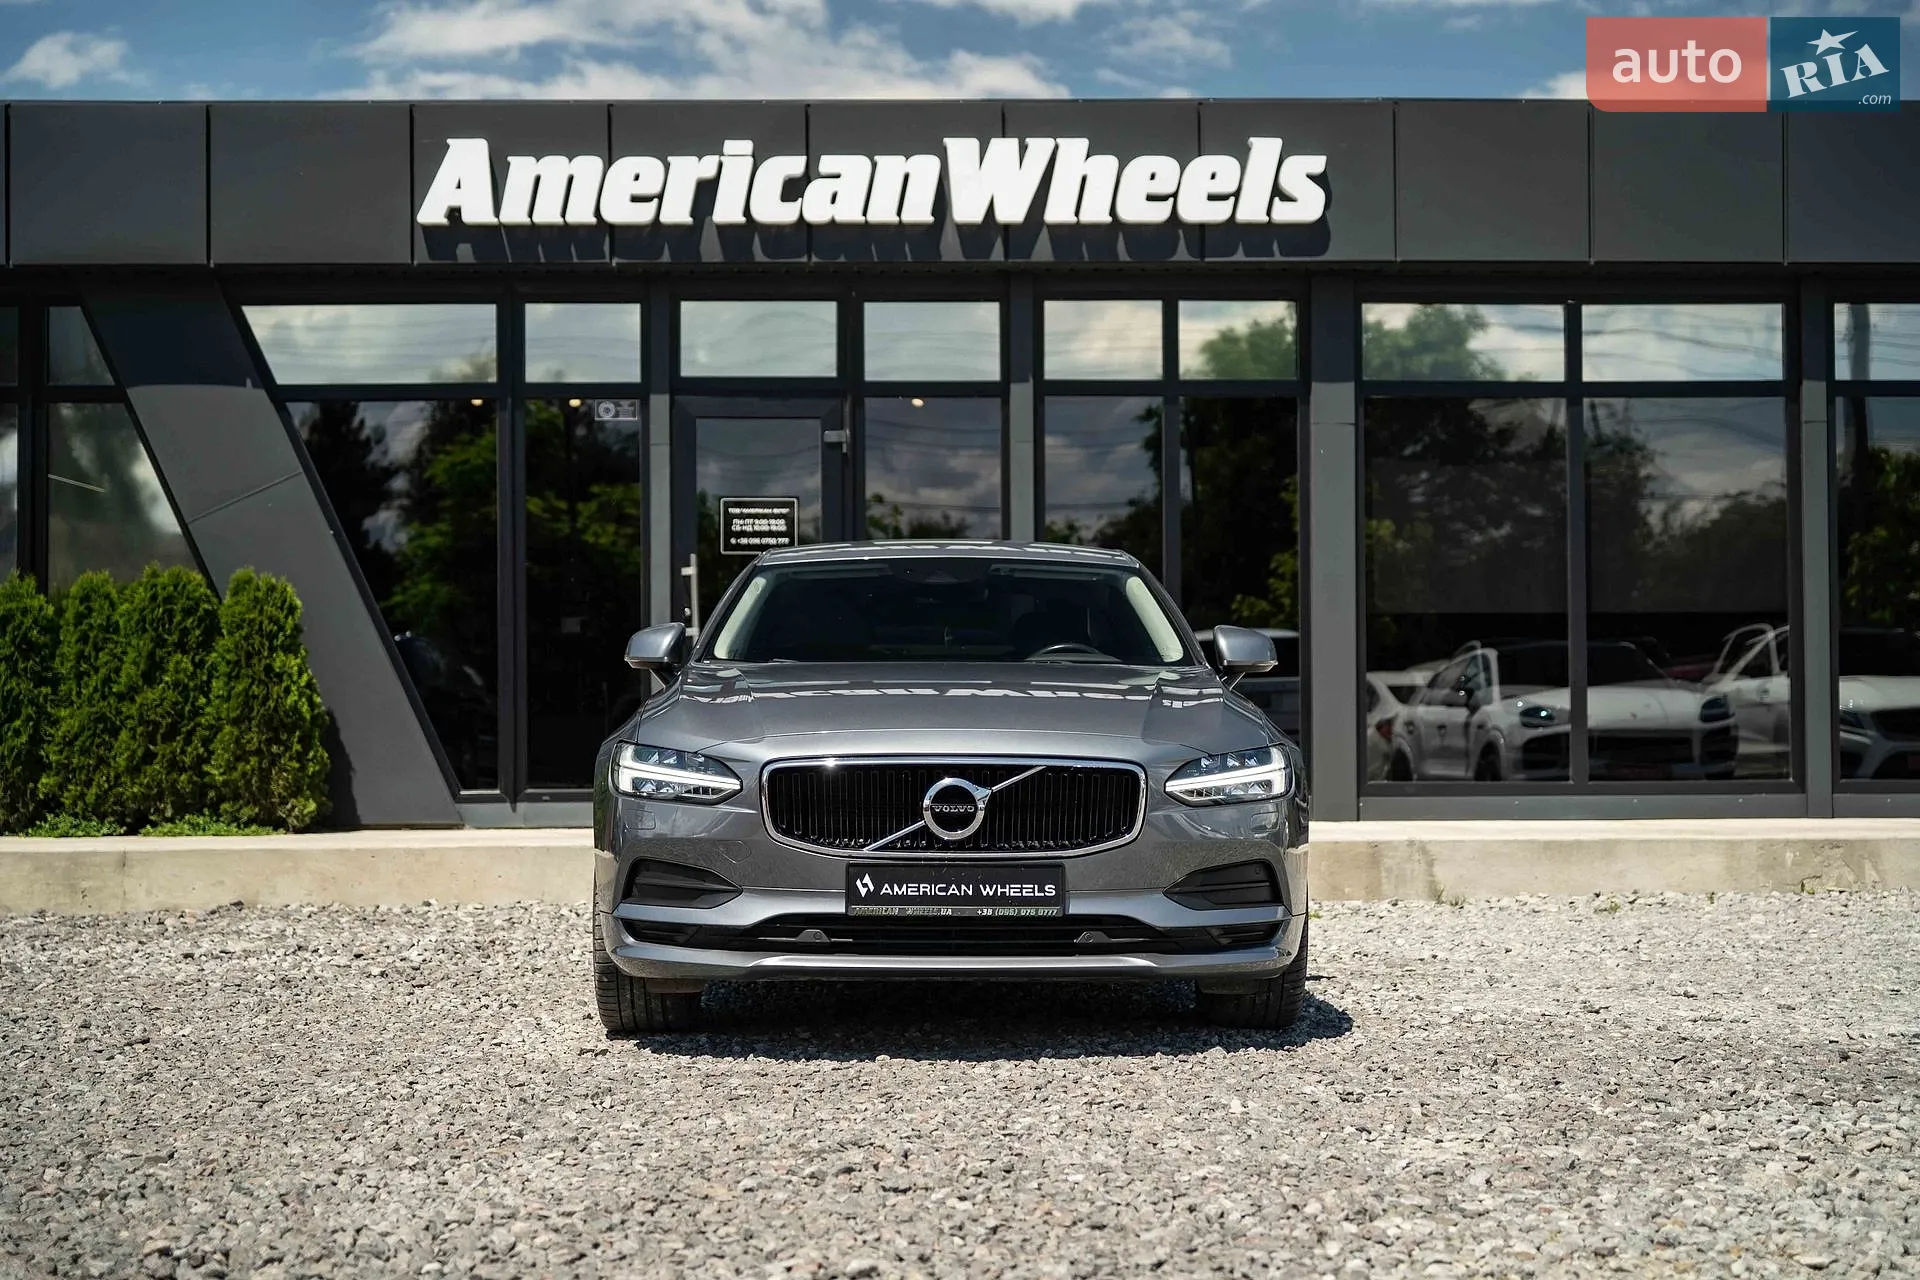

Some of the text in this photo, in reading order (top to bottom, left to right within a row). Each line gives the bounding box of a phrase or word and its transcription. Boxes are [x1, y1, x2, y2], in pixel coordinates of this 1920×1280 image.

[416, 137, 1329, 226] AmericanWheels
[931, 805, 975, 813] VOLVO
[880, 884, 1056, 896] AMERICAN WHEELS
[853, 907, 899, 916] AMERICAN
[976, 908, 993, 916] +38
[1037, 908, 1058, 916] 0777
